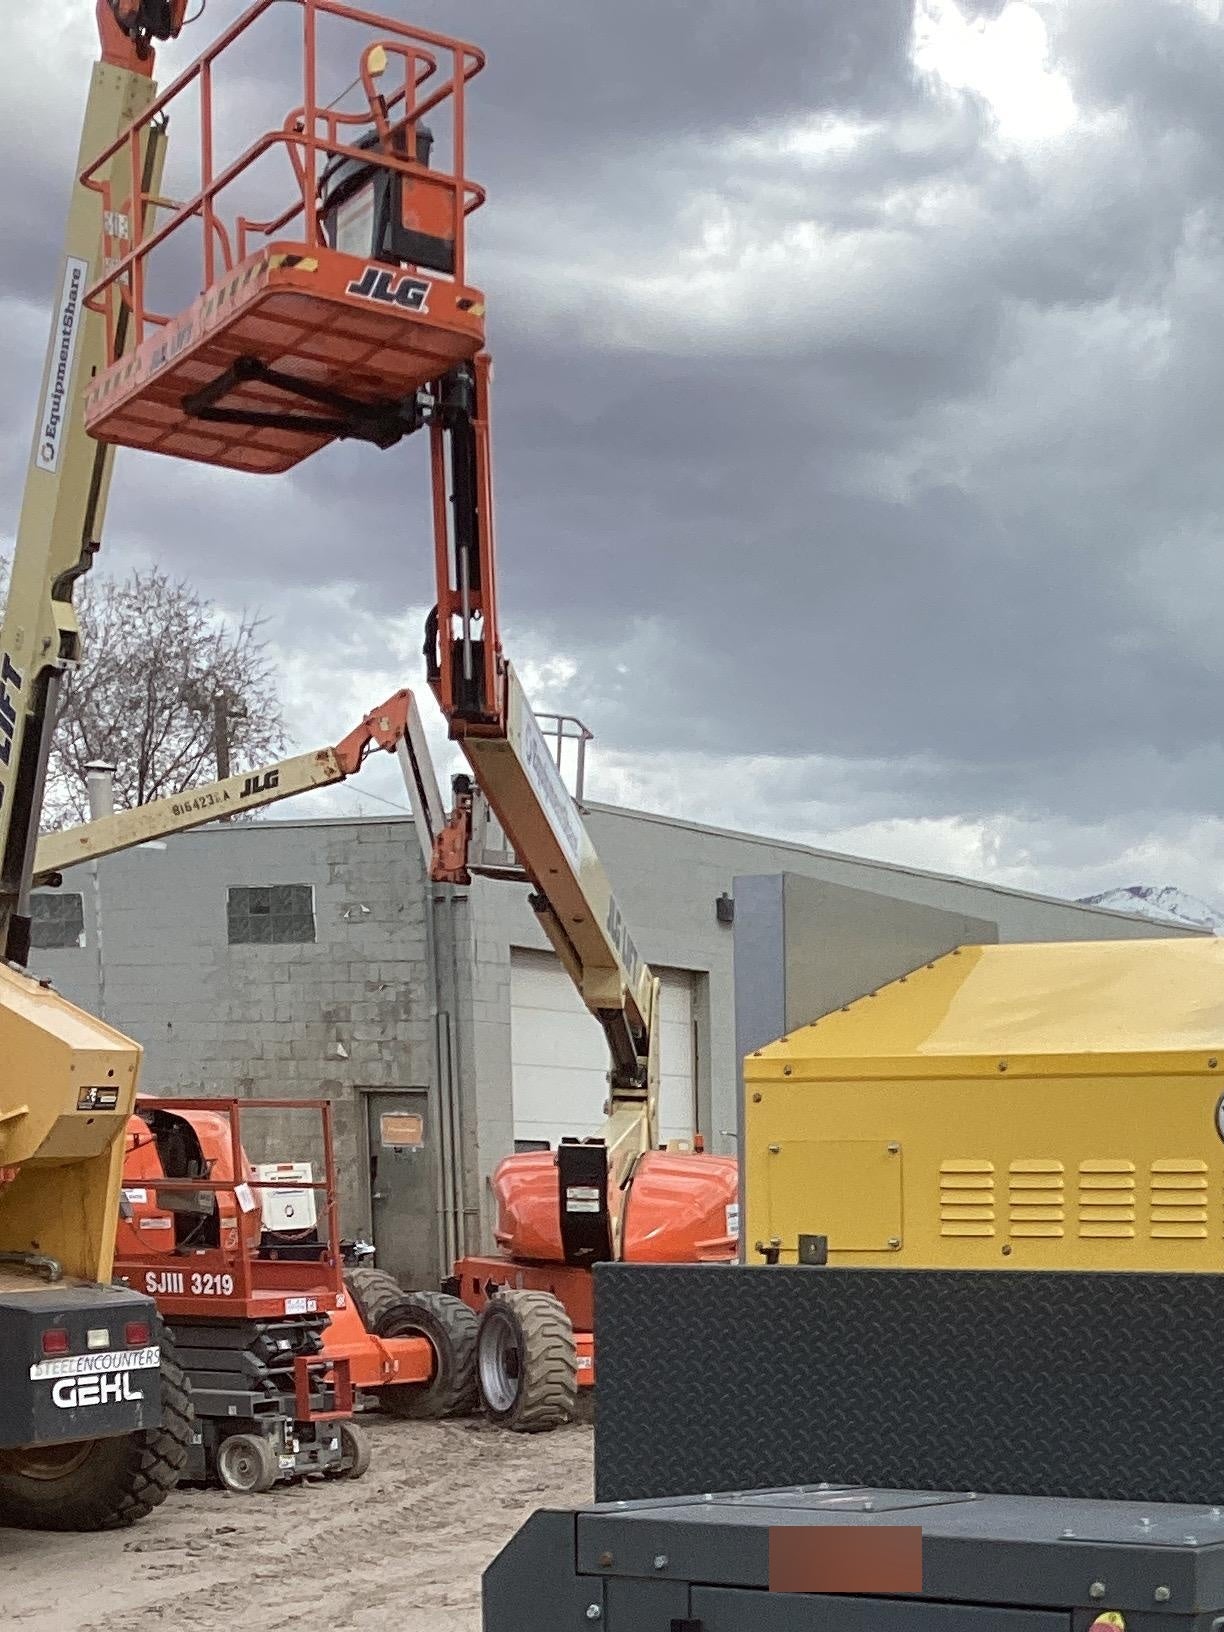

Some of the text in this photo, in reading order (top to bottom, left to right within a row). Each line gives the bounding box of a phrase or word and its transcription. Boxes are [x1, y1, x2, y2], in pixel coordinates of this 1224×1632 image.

[347, 267, 430, 311] JLG
[45, 268, 81, 440] EquipmentShare
[240, 769, 279, 798] JLG
[145, 1271, 233, 1296] SJIII 3219
[52, 1371, 144, 1409] GEHL
